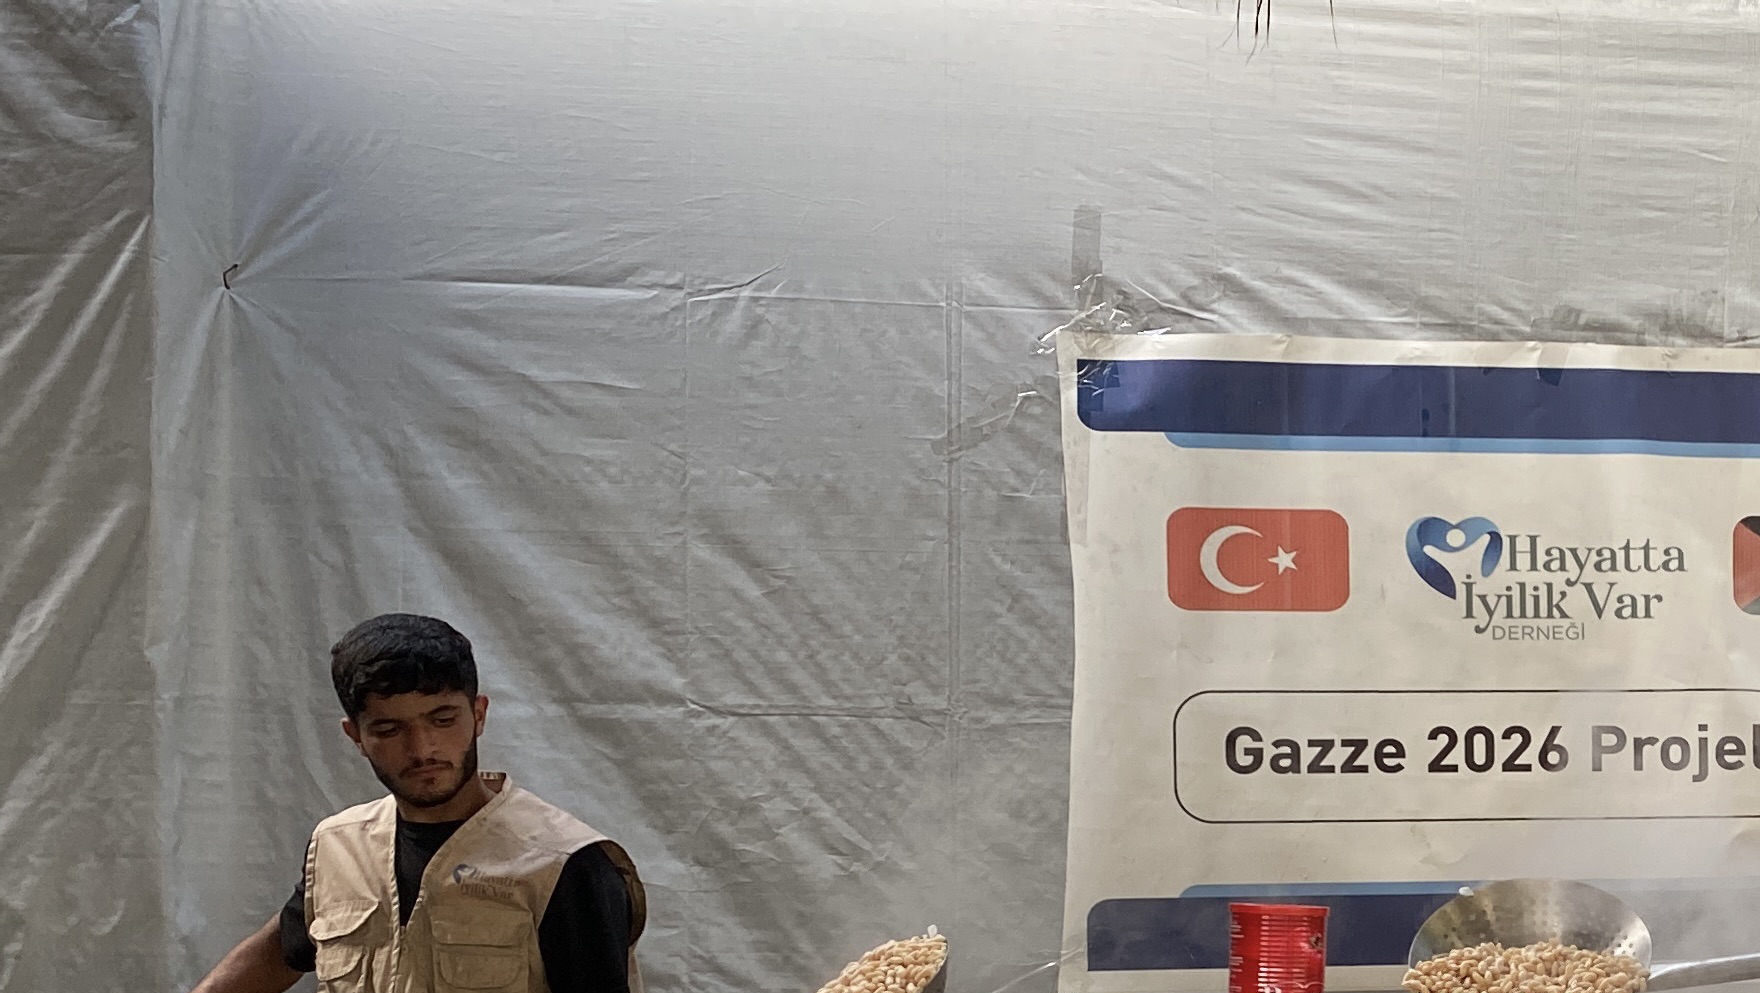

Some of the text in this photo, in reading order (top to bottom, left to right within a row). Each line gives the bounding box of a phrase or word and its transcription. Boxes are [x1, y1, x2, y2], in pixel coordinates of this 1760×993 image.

[1505, 534, 1688, 588] Hayatta
[1461, 574, 1664, 635] İyilik Var
[1224, 726, 1406, 775] Gazze
[1427, 726, 1569, 774] 2026
